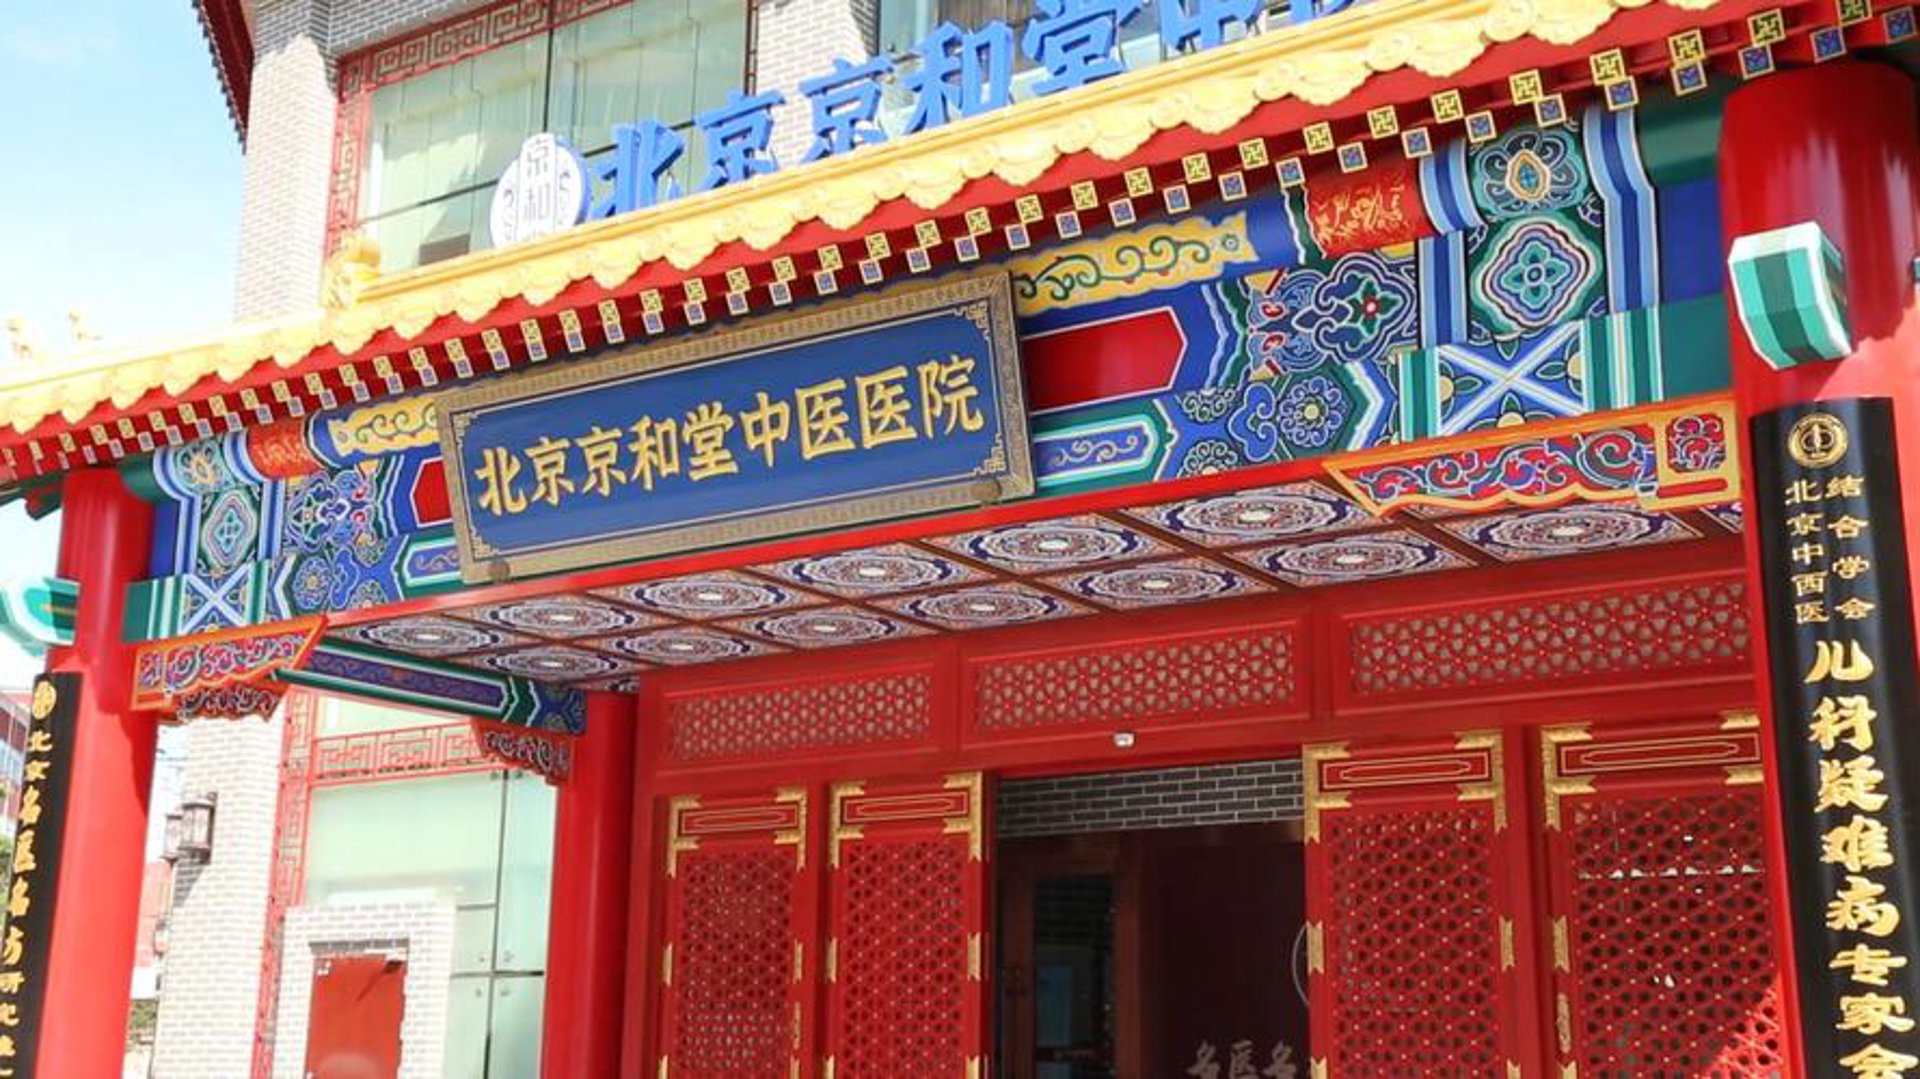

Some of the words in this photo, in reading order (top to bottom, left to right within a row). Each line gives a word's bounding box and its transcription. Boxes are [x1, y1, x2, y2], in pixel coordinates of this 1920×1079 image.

[590, 0, 1347, 219] 北京京和堂中
[518, 134, 554, 238] 京和
[474, 354, 985, 517] 北京京和堂中医医院
[1785, 479, 1831, 625] 北京中西医
[1825, 473, 1876, 620] 结合学会
